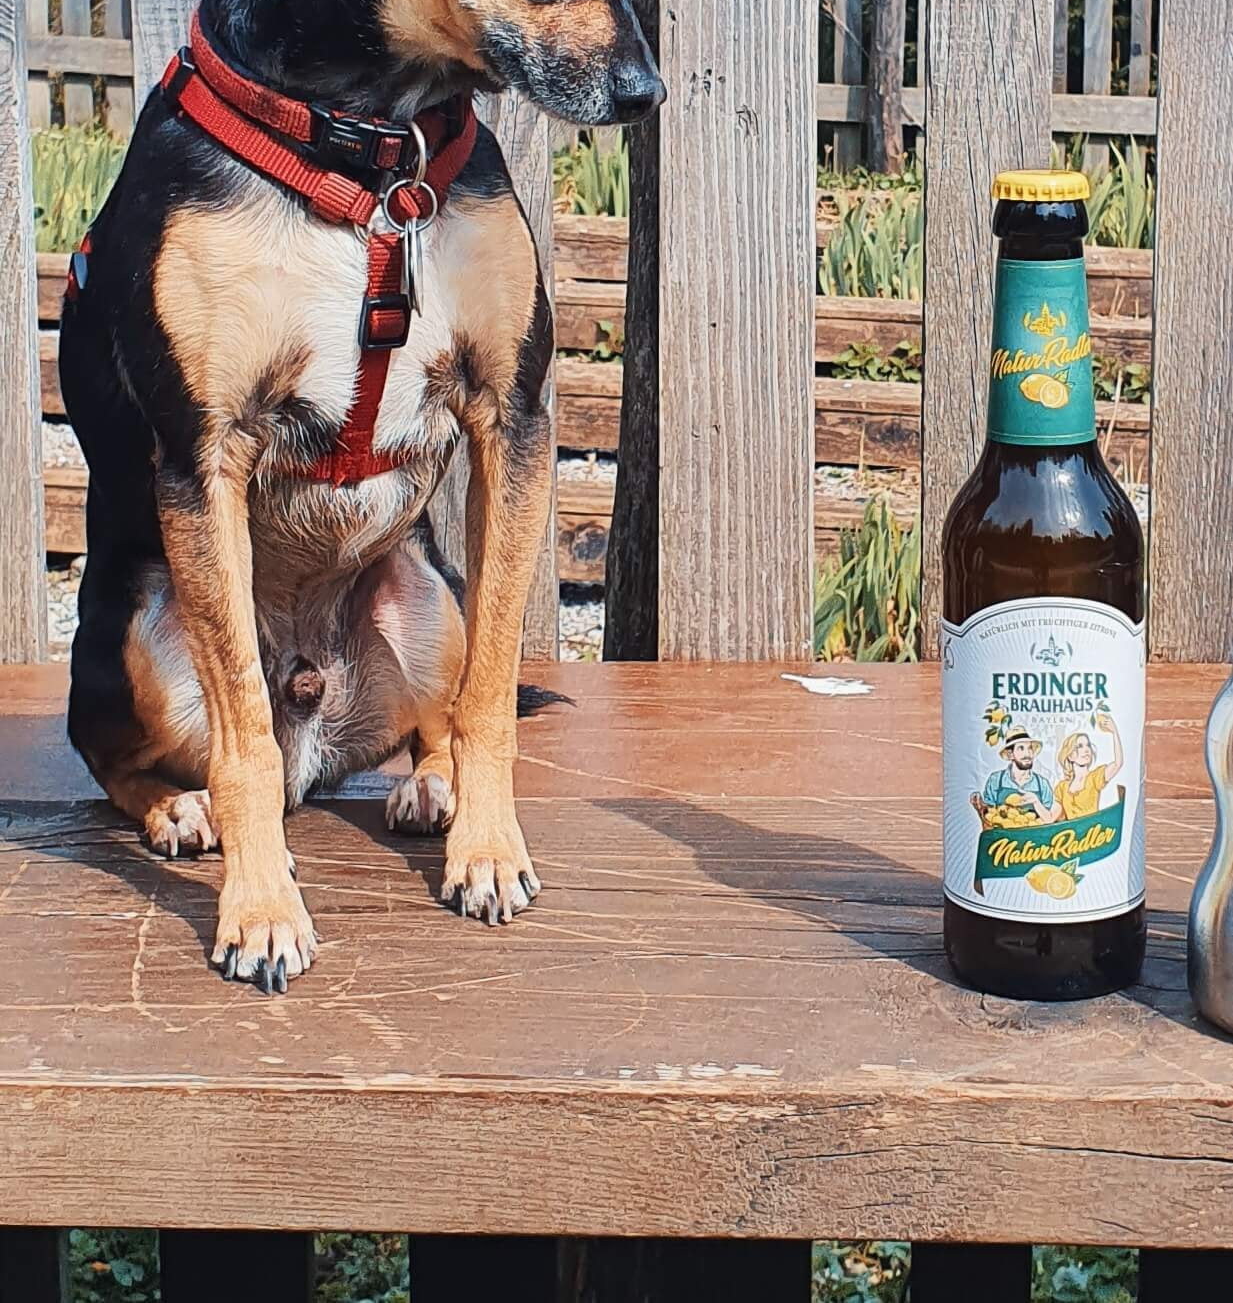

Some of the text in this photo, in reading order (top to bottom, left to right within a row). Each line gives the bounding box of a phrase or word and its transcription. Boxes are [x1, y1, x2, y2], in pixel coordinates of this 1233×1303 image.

[991, 331, 1091, 380] NaturRadle
[1021, 618, 1036, 628] MIT
[1038, 618, 1088, 629] FRUCHTIGER
[992, 671, 1109, 700] ERDINGER
[1010, 696, 1093, 713] BRAUHAUS
[987, 823, 1116, 869] NaturRadler
